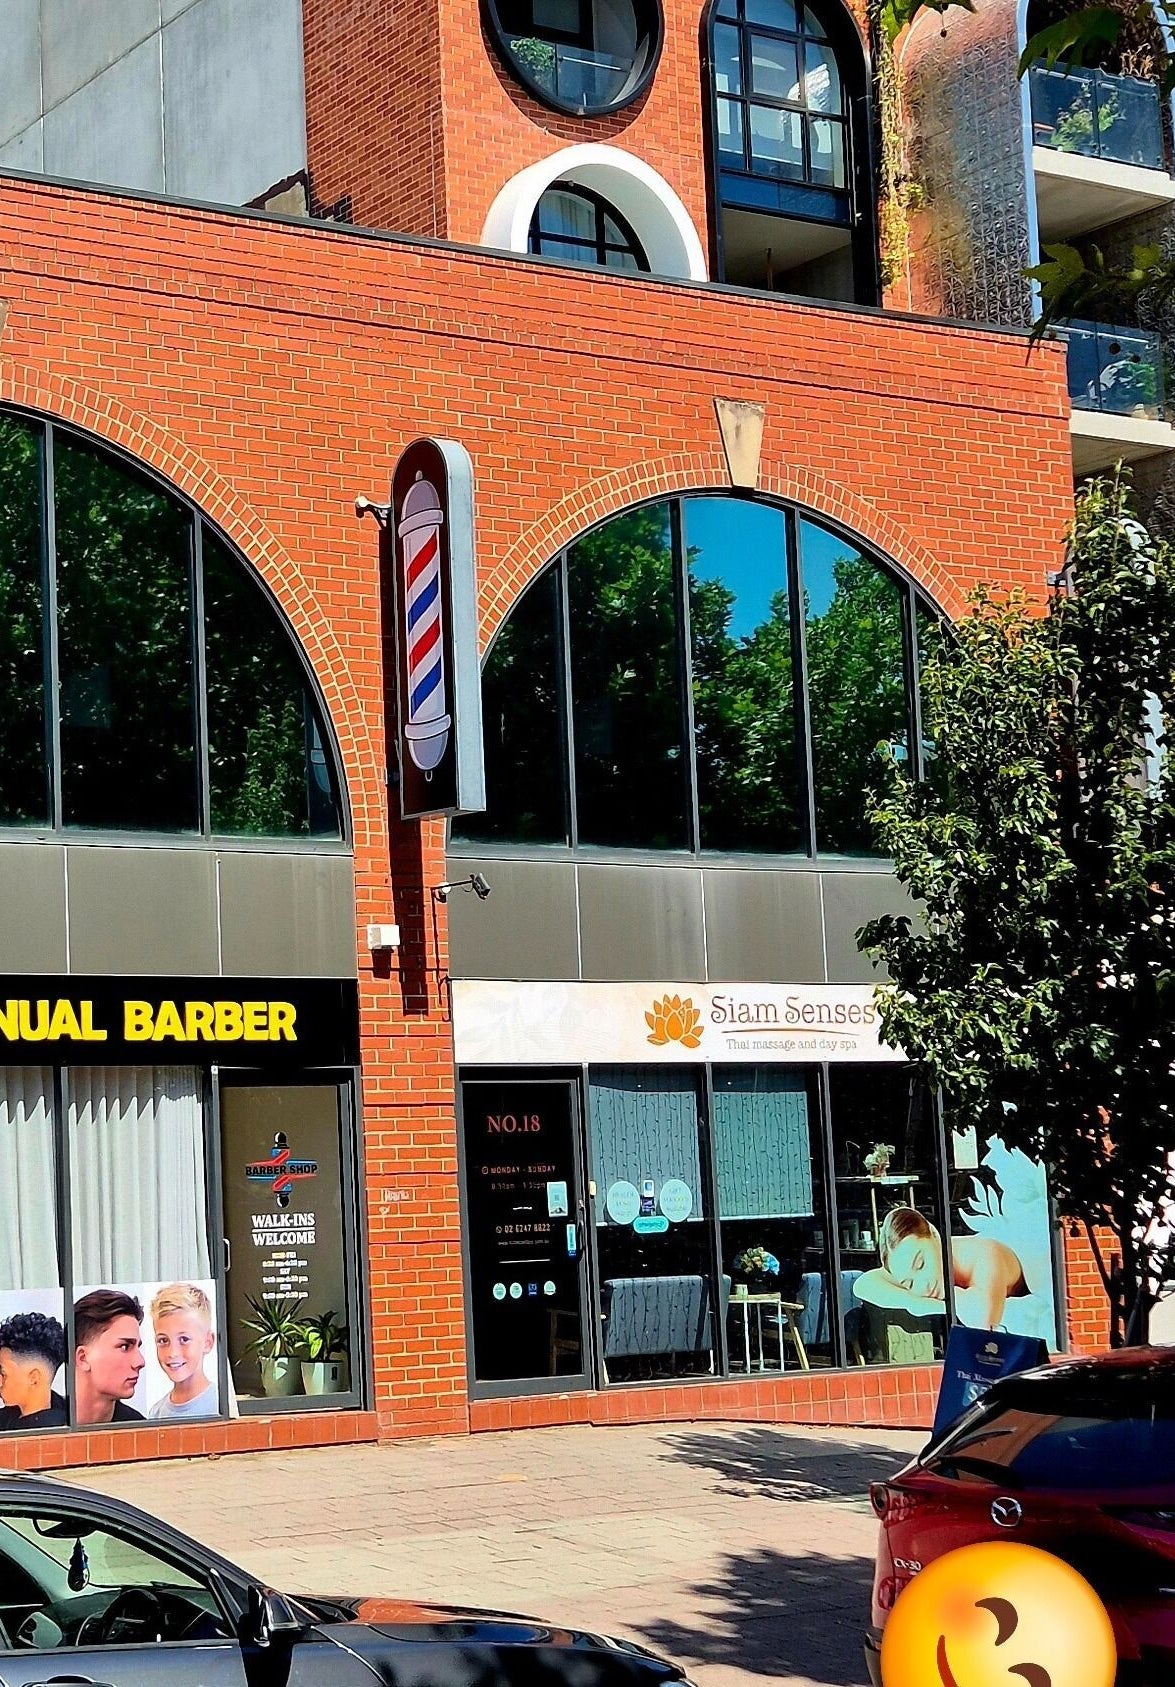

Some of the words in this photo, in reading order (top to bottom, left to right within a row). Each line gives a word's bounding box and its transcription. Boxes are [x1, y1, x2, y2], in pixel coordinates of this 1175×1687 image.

[710, 995, 778, 1024] Siam
[785, 996, 875, 1024] Senses
[123, 1000, 298, 1042] BARBER
[726, 1038, 749, 1050] Thai
[752, 1040, 796, 1051] massage
[798, 1038, 817, 1050] and
[819, 1038, 837, 1051] day
[840, 1040, 857, 1051] spa
[486, 1114, 541, 1133] NO.18
[245, 1165, 286, 1176] BARBER
[289, 1164, 318, 1174] SHOP
[490, 1166, 520, 1174] MONDAY
[528, 1165, 556, 1173] SUNDAY
[251, 1212, 316, 1228] WALK-INS
[252, 1231, 316, 1246] WELCOME
